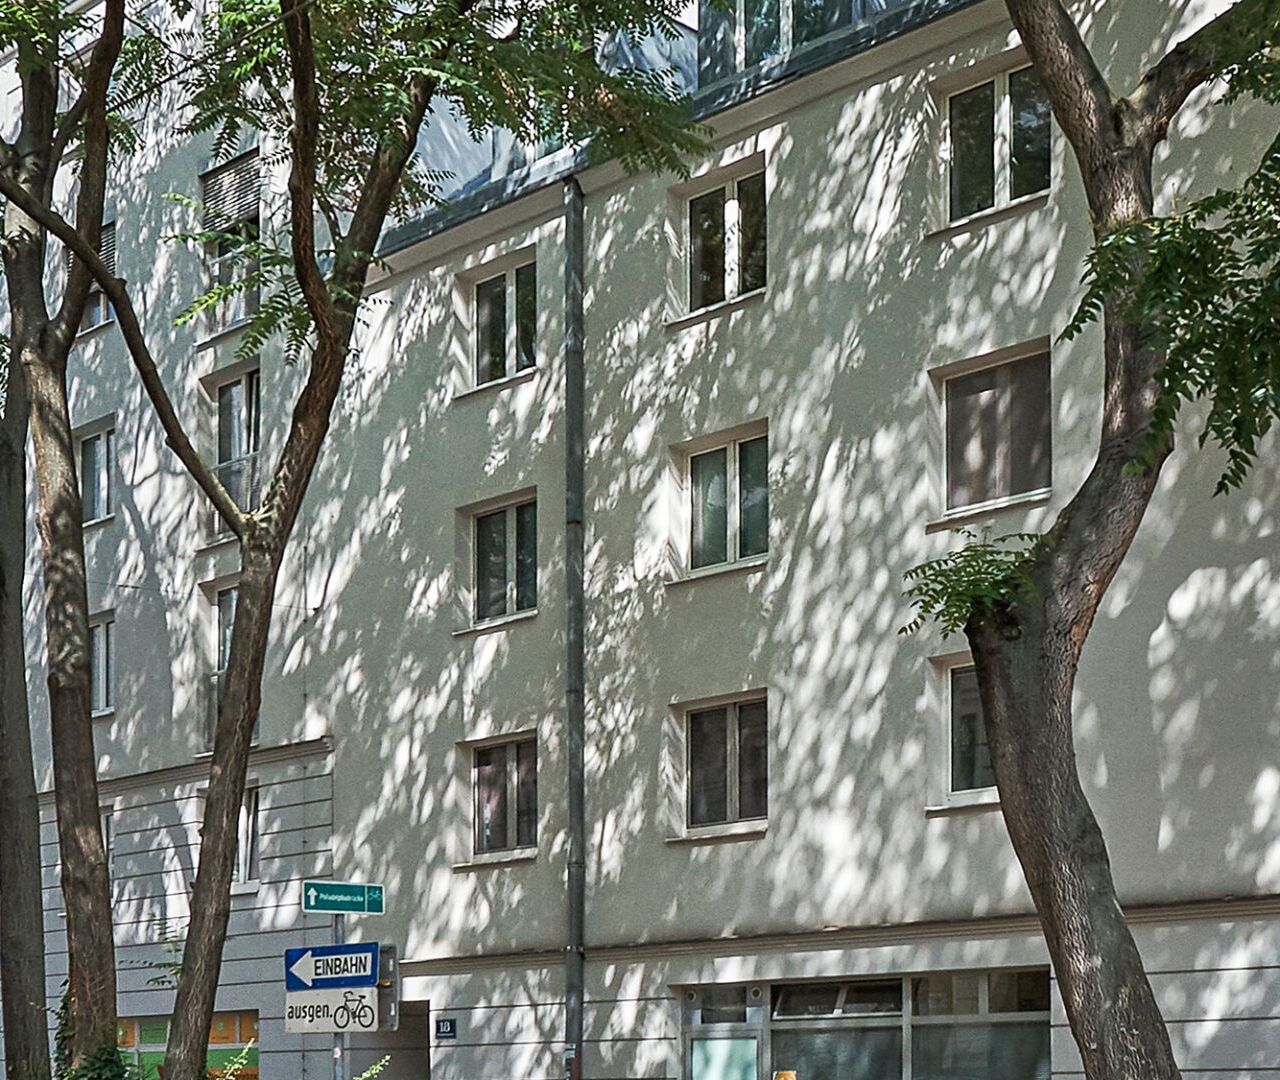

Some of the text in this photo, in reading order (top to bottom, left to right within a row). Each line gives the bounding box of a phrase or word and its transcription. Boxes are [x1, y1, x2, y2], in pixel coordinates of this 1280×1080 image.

[314, 956, 367, 976] EINBAHN
[287, 1004, 333, 1023] ausgen.
[439, 1021, 451, 1032] 18
